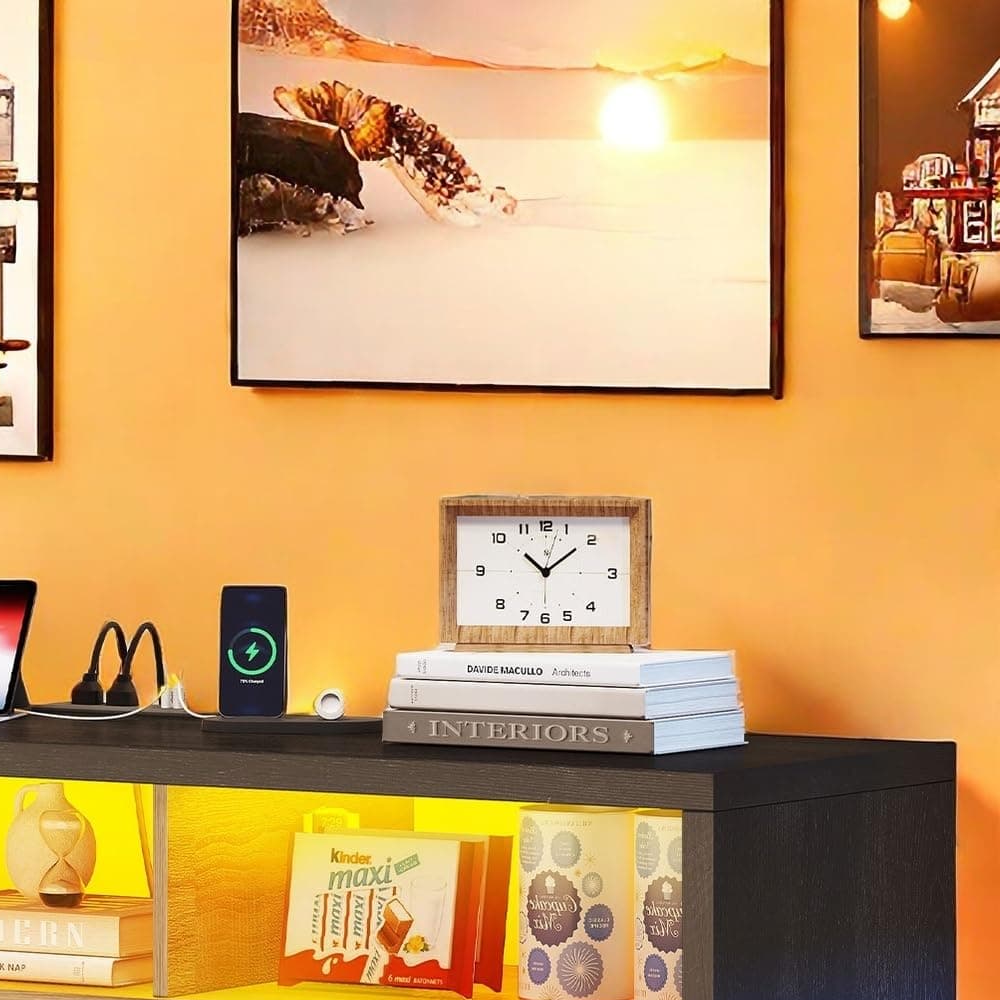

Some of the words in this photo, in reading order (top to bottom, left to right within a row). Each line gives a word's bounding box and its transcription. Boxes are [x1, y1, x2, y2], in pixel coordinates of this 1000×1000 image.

[519, 523, 529, 535] 11
[539, 520, 553, 532] 12
[492, 532, 506, 544] 10
[586, 534, 597, 546] 2
[475, 565, 485, 576] 9
[607, 568, 618, 579] 3
[495, 598, 505, 610] 8
[585, 601, 596, 612] 4
[520, 610, 530, 621] 7
[540, 612, 550, 624] 6
[562, 610, 572, 621] 5
[467, 664, 499, 674] DAVIDE
[500, 665, 544, 676] MACULLO
[551, 667, 591, 678] Architects
[428, 719, 610, 744] INTERIORS
[330, 848, 372, 865] Kinder
[328, 857, 393, 890] maxi
[330, 893, 342, 936] maxi
[352, 894, 364, 937] maxi
[7, 963, 26, 972] NAP
[387, 974, 394, 983] 6
